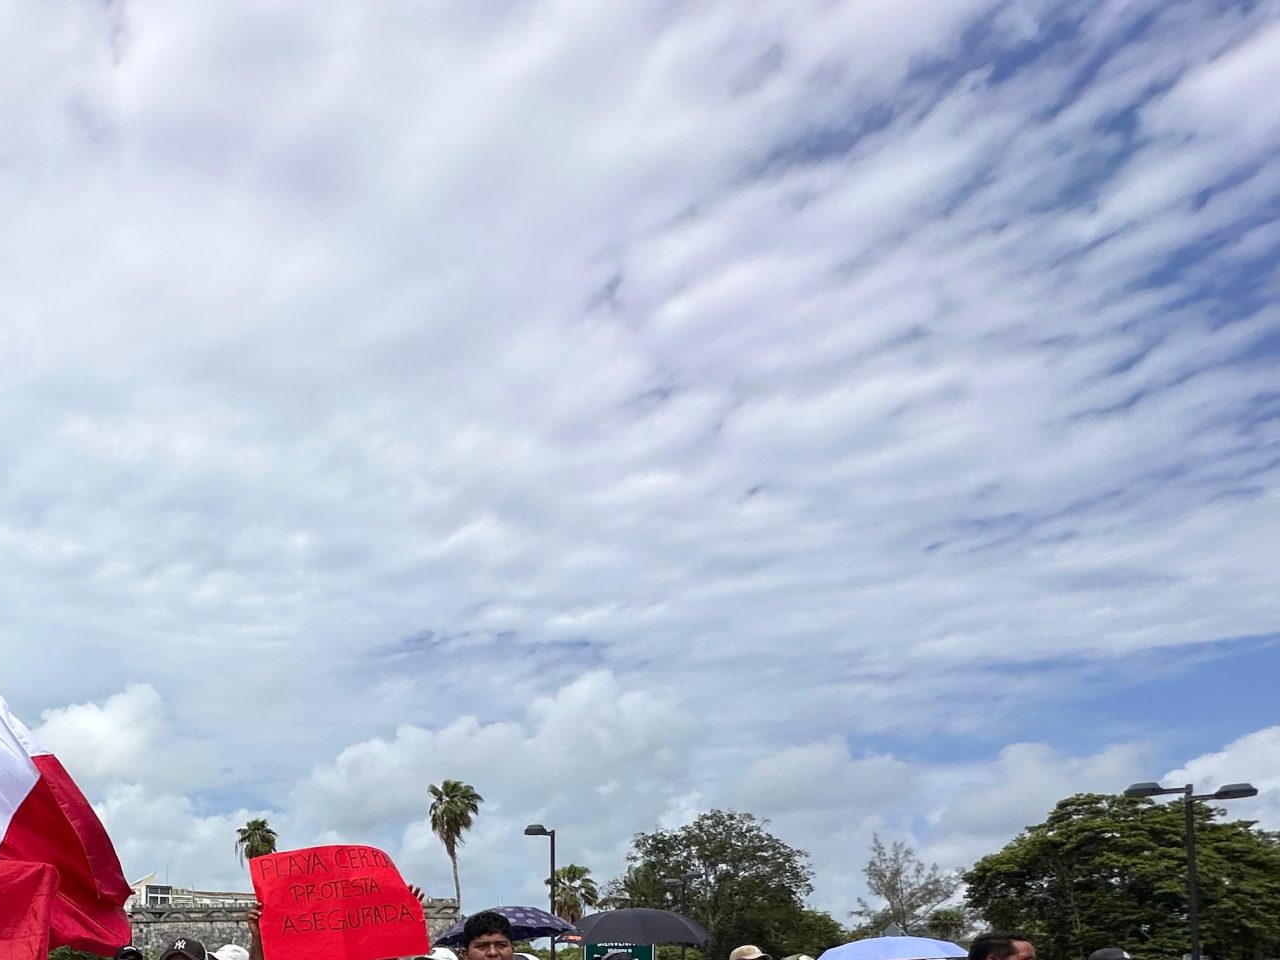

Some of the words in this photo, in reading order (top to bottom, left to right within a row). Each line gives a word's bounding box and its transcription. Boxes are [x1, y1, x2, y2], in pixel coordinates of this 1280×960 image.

[259, 853, 327, 880] PLAYA
[289, 877, 382, 904] PROTESTA
[282, 904, 415, 936] ASEGURADA
